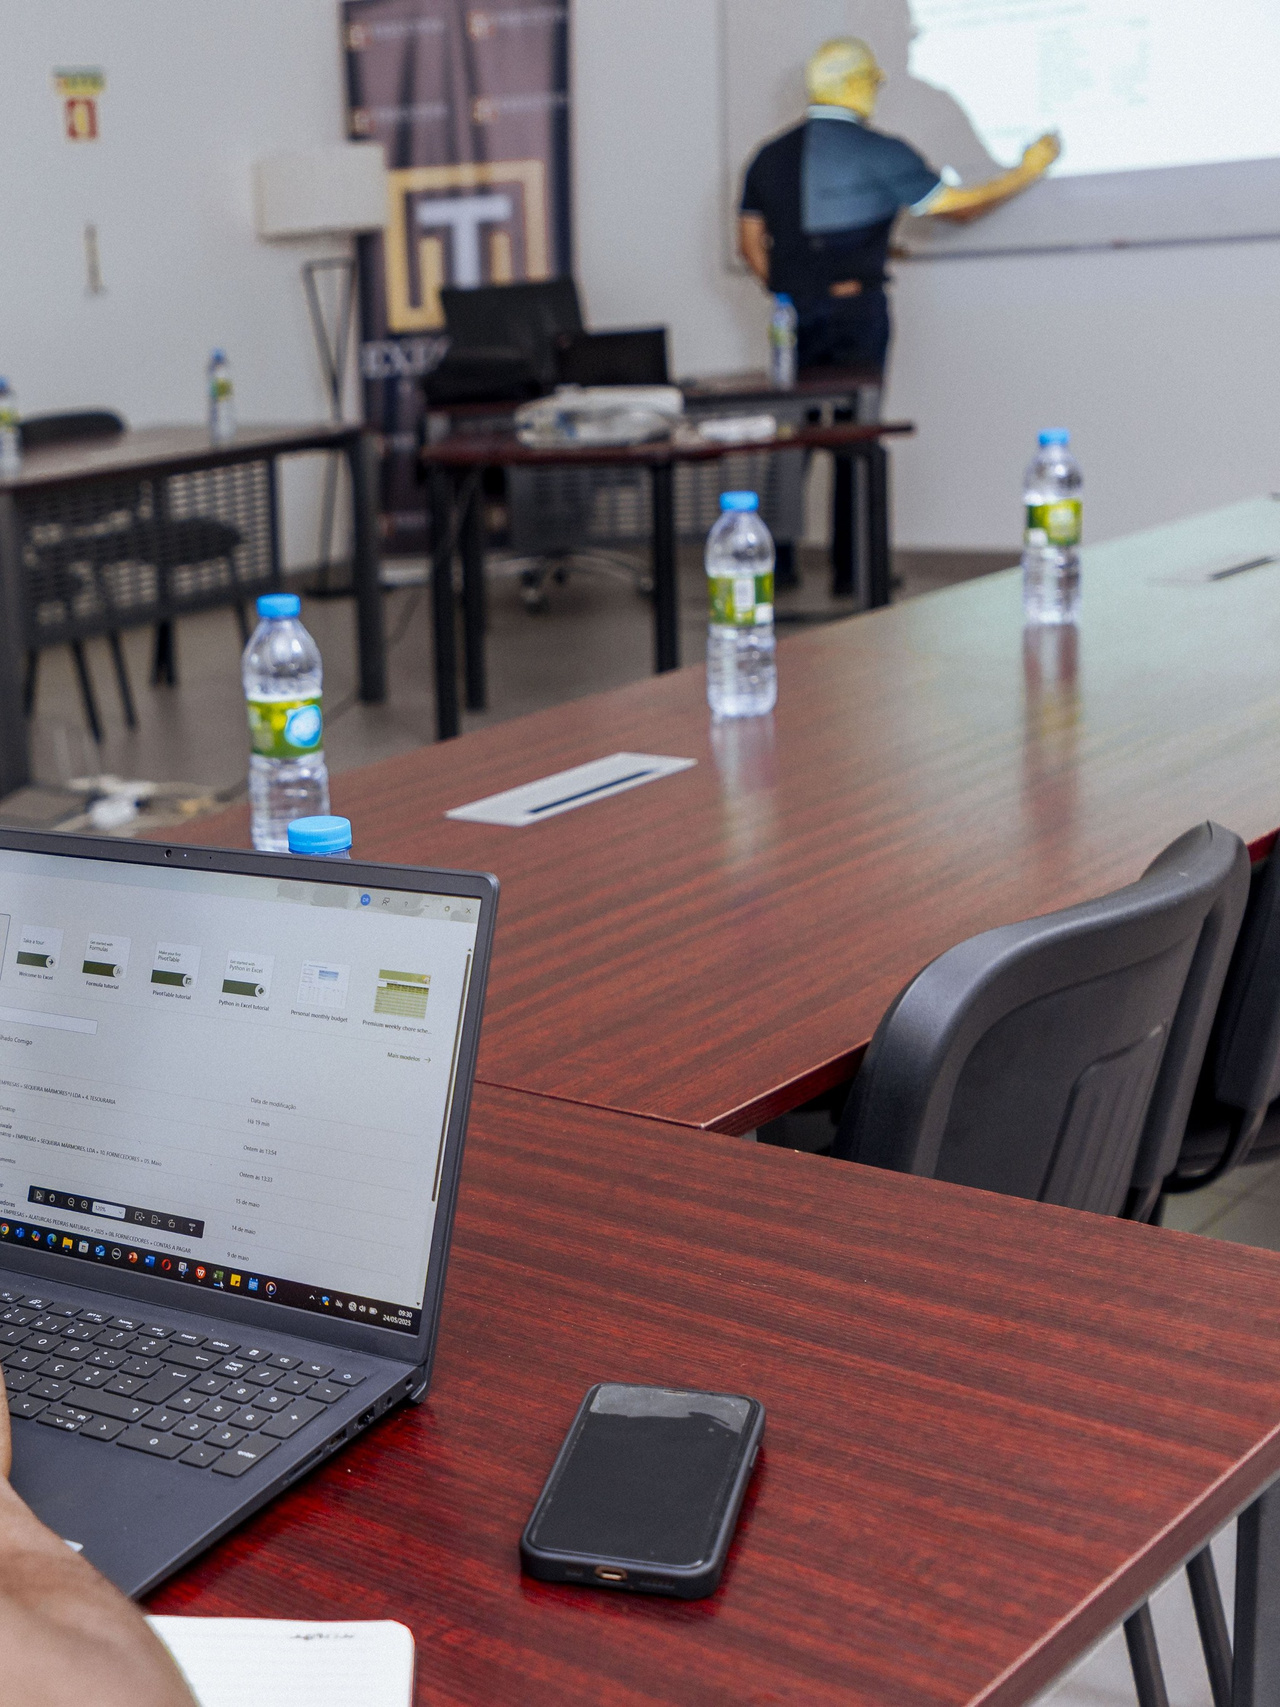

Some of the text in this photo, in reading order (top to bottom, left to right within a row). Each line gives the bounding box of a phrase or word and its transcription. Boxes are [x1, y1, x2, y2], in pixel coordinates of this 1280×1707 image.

[157, 955, 180, 963] PivotTable
[228, 964, 245, 972] Python
[103, 982, 119, 990] tutorial
[152, 989, 175, 998] PivotTable
[218, 998, 234, 1006] Python
[252, 1003, 269, 1011] tutorial
[290, 1009, 348, 1023] Personal monthly budget
[361, 1019, 383, 1027] Premium
[384, 1022, 402, 1031] weekly
[13, 1036, 33, 1046] Comigo
[398, 1053, 420, 1062] modelos
[89, 1095, 116, 1104] TESOURARIA
[268, 1100, 297, 1111] modificação
[242, 1144, 258, 1152] Ontem
[105, 1150, 140, 1162] FORNECEDORES
[238, 1171, 254, 1179] Ontem
[114, 1232, 149, 1244] FORNECEDORES
[153, 1240, 171, 1249] CONTAS
[175, 1245, 192, 1253] PAGAR
[381, 1313, 412, 1327] 24/05/2025
[181, 1333, 197, 1341] insert
